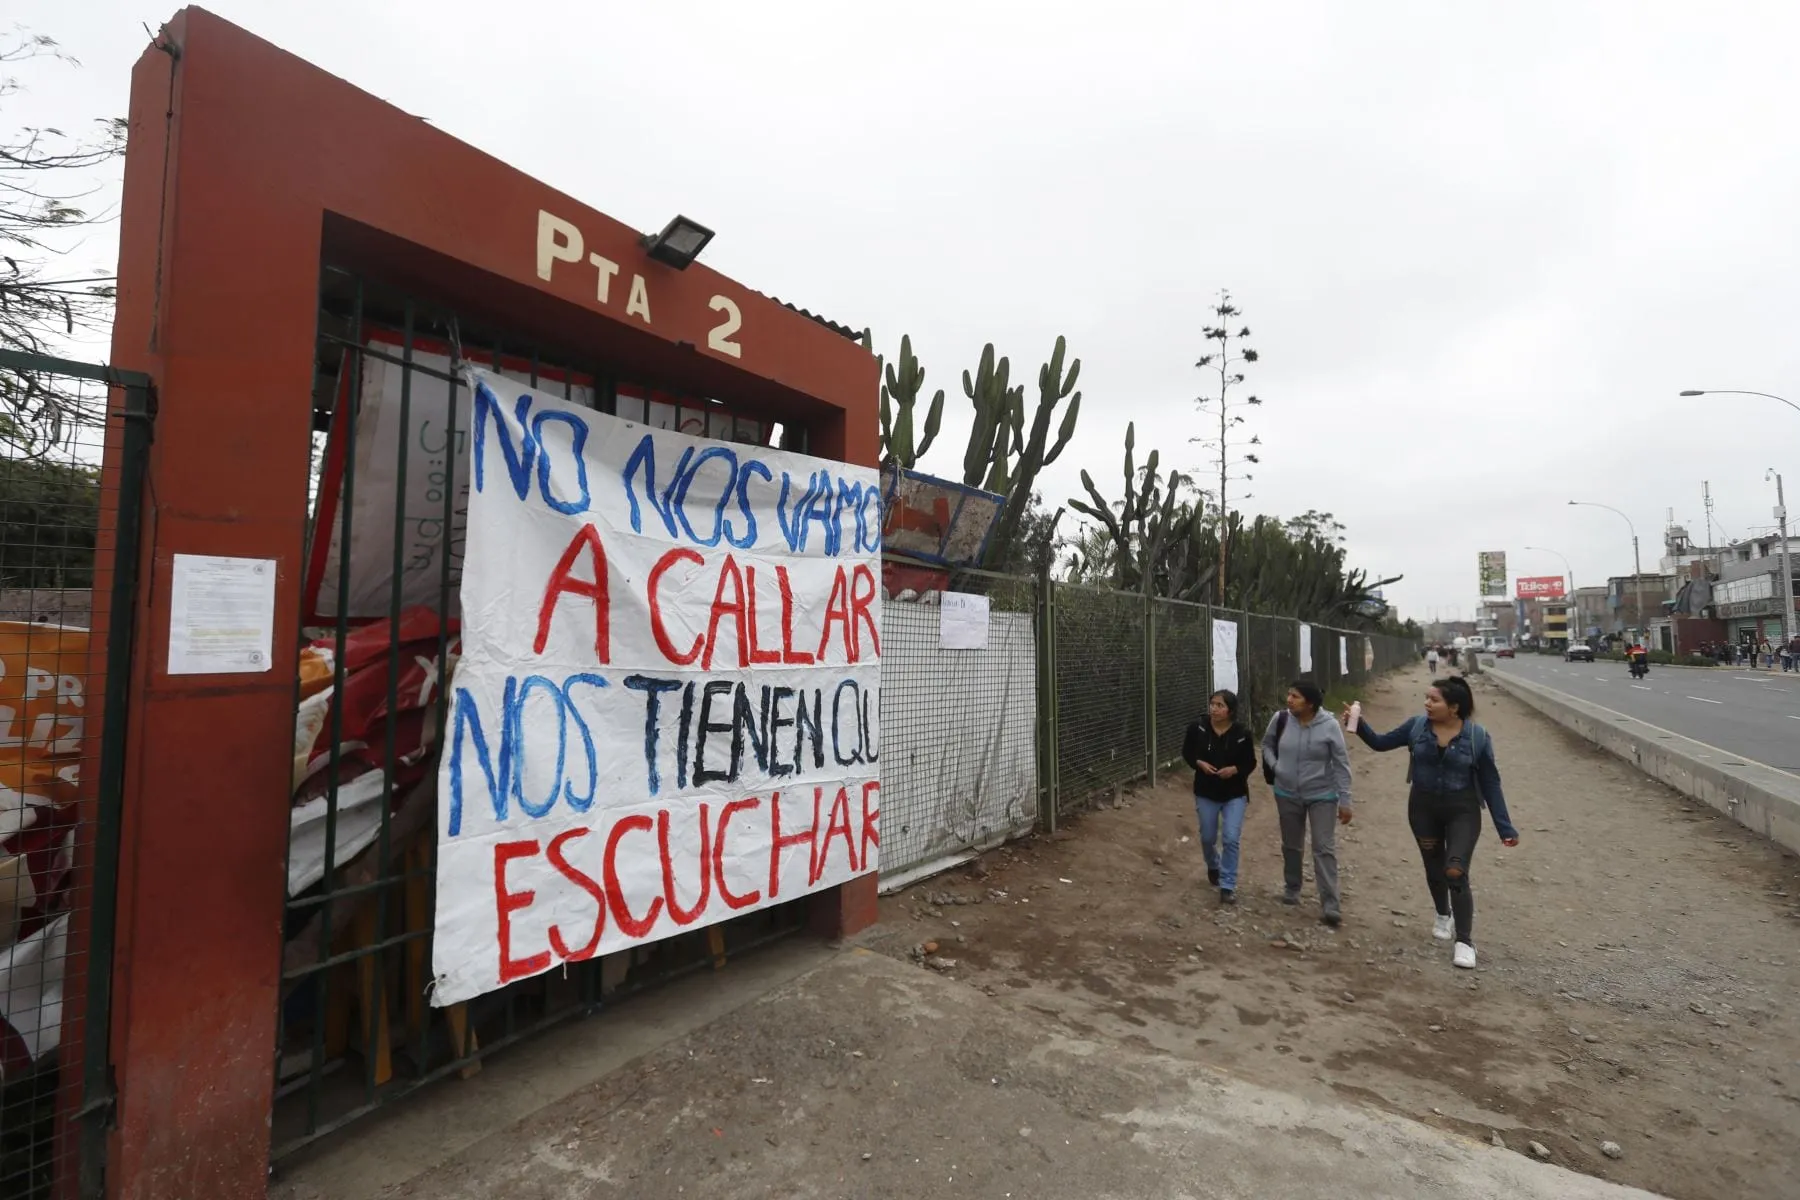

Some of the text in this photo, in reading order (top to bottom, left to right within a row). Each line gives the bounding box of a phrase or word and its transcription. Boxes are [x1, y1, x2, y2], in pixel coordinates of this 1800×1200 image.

[537, 209, 742, 359] PTA 2
[474, 380, 590, 516] NO
[622, 434, 772, 549] NOS
[533, 523, 611, 666] A
[647, 547, 881, 672] CALLAR
[448, 673, 610, 837] NOS
[623, 673, 825, 796] TIENEN
[494, 780, 881, 985] ESCUCHAR
